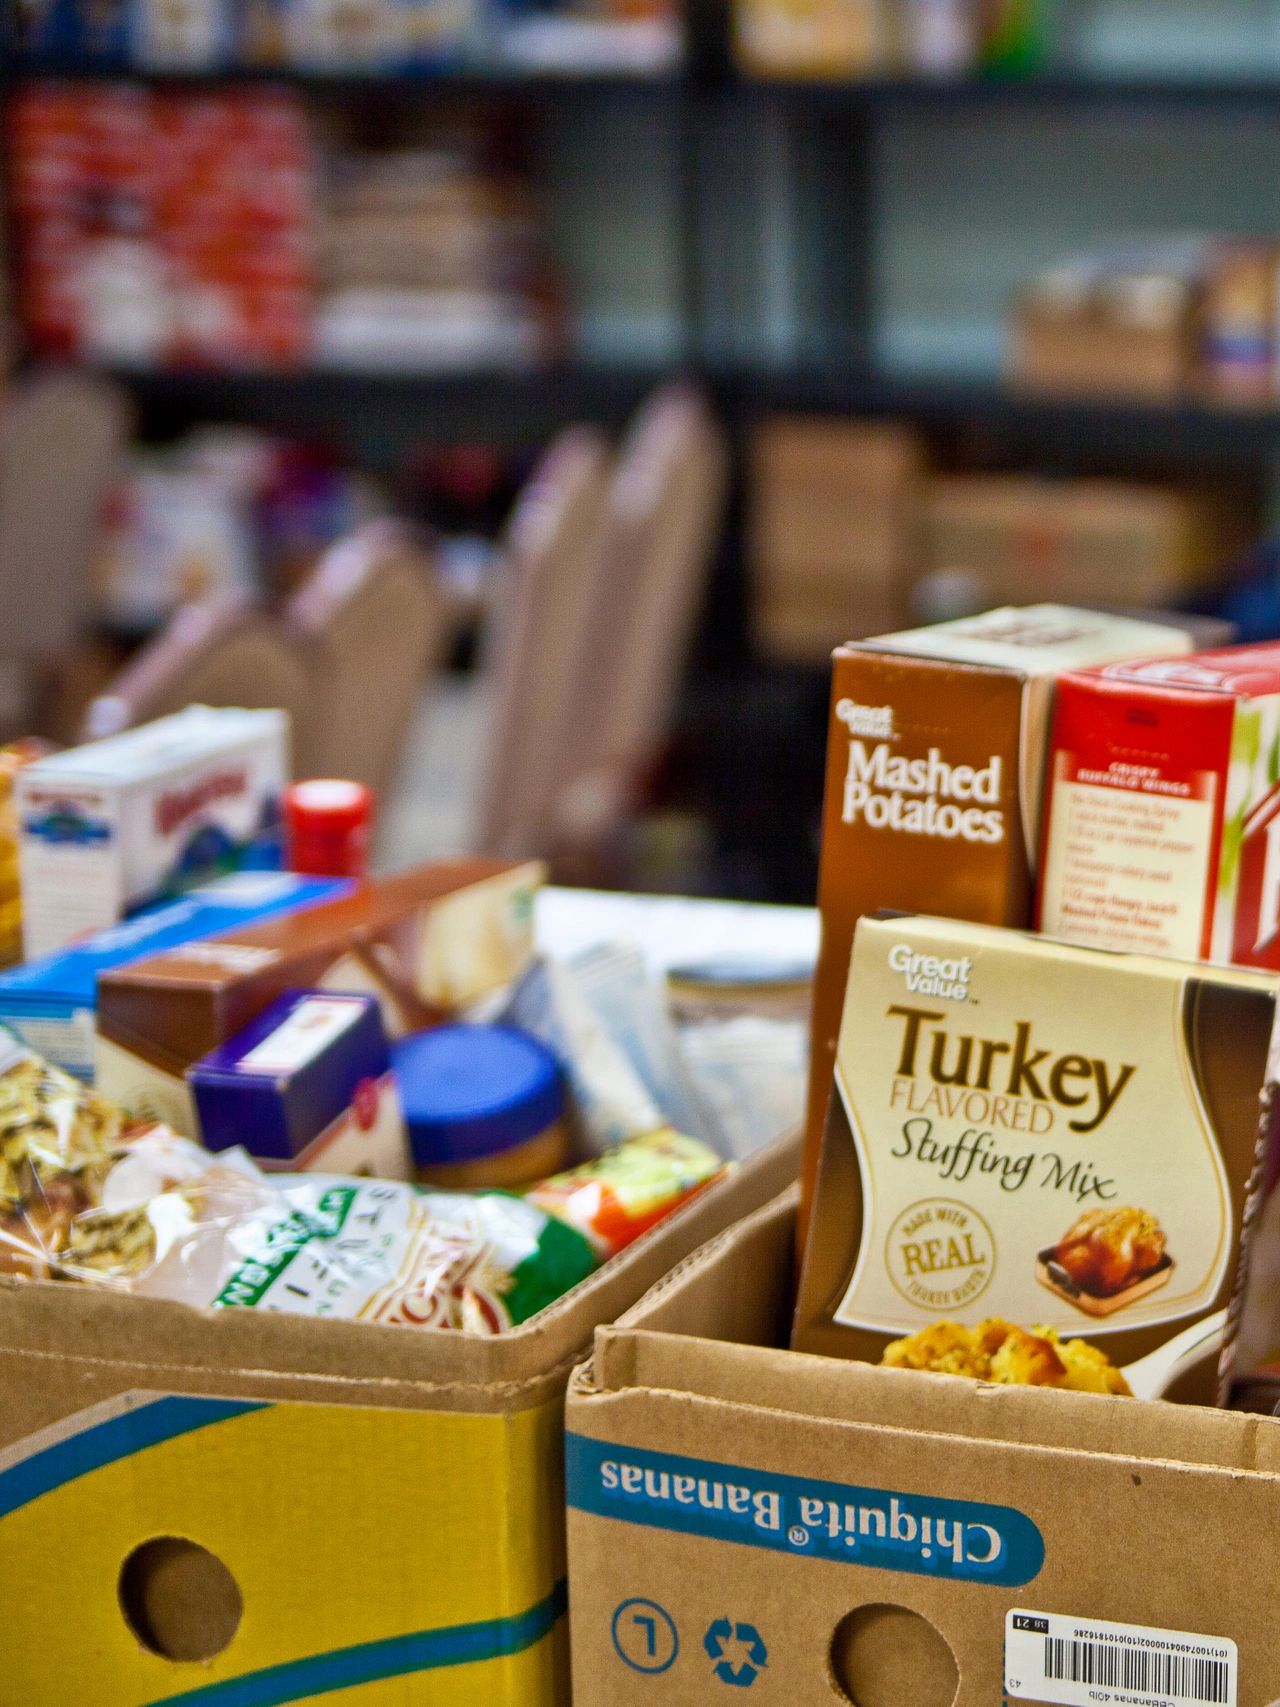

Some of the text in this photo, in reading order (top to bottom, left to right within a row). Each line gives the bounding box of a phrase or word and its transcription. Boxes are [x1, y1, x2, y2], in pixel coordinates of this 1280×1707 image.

[848, 740, 1002, 803] Mashed
[1077, 768, 1191, 796] BUFFALO WINGS
[842, 777, 1004, 843] Potatoes
[888, 944, 972, 982] Great
[904, 971, 968, 1000] Value
[886, 1004, 1138, 1133] Turkey
[888, 1078, 1056, 1134] FLAVORED
[891, 1117, 1118, 1203] Stuffing Mix
[936, 1208, 968, 1229] WITH
[901, 1233, 986, 1277] REAL
[599, 1461, 780, 1532] Bananas
[1016, 1617, 1029, 1629] 21
[1008, 1678, 1022, 1688] 43
[1088, 1690, 1111, 1704] 40lb
